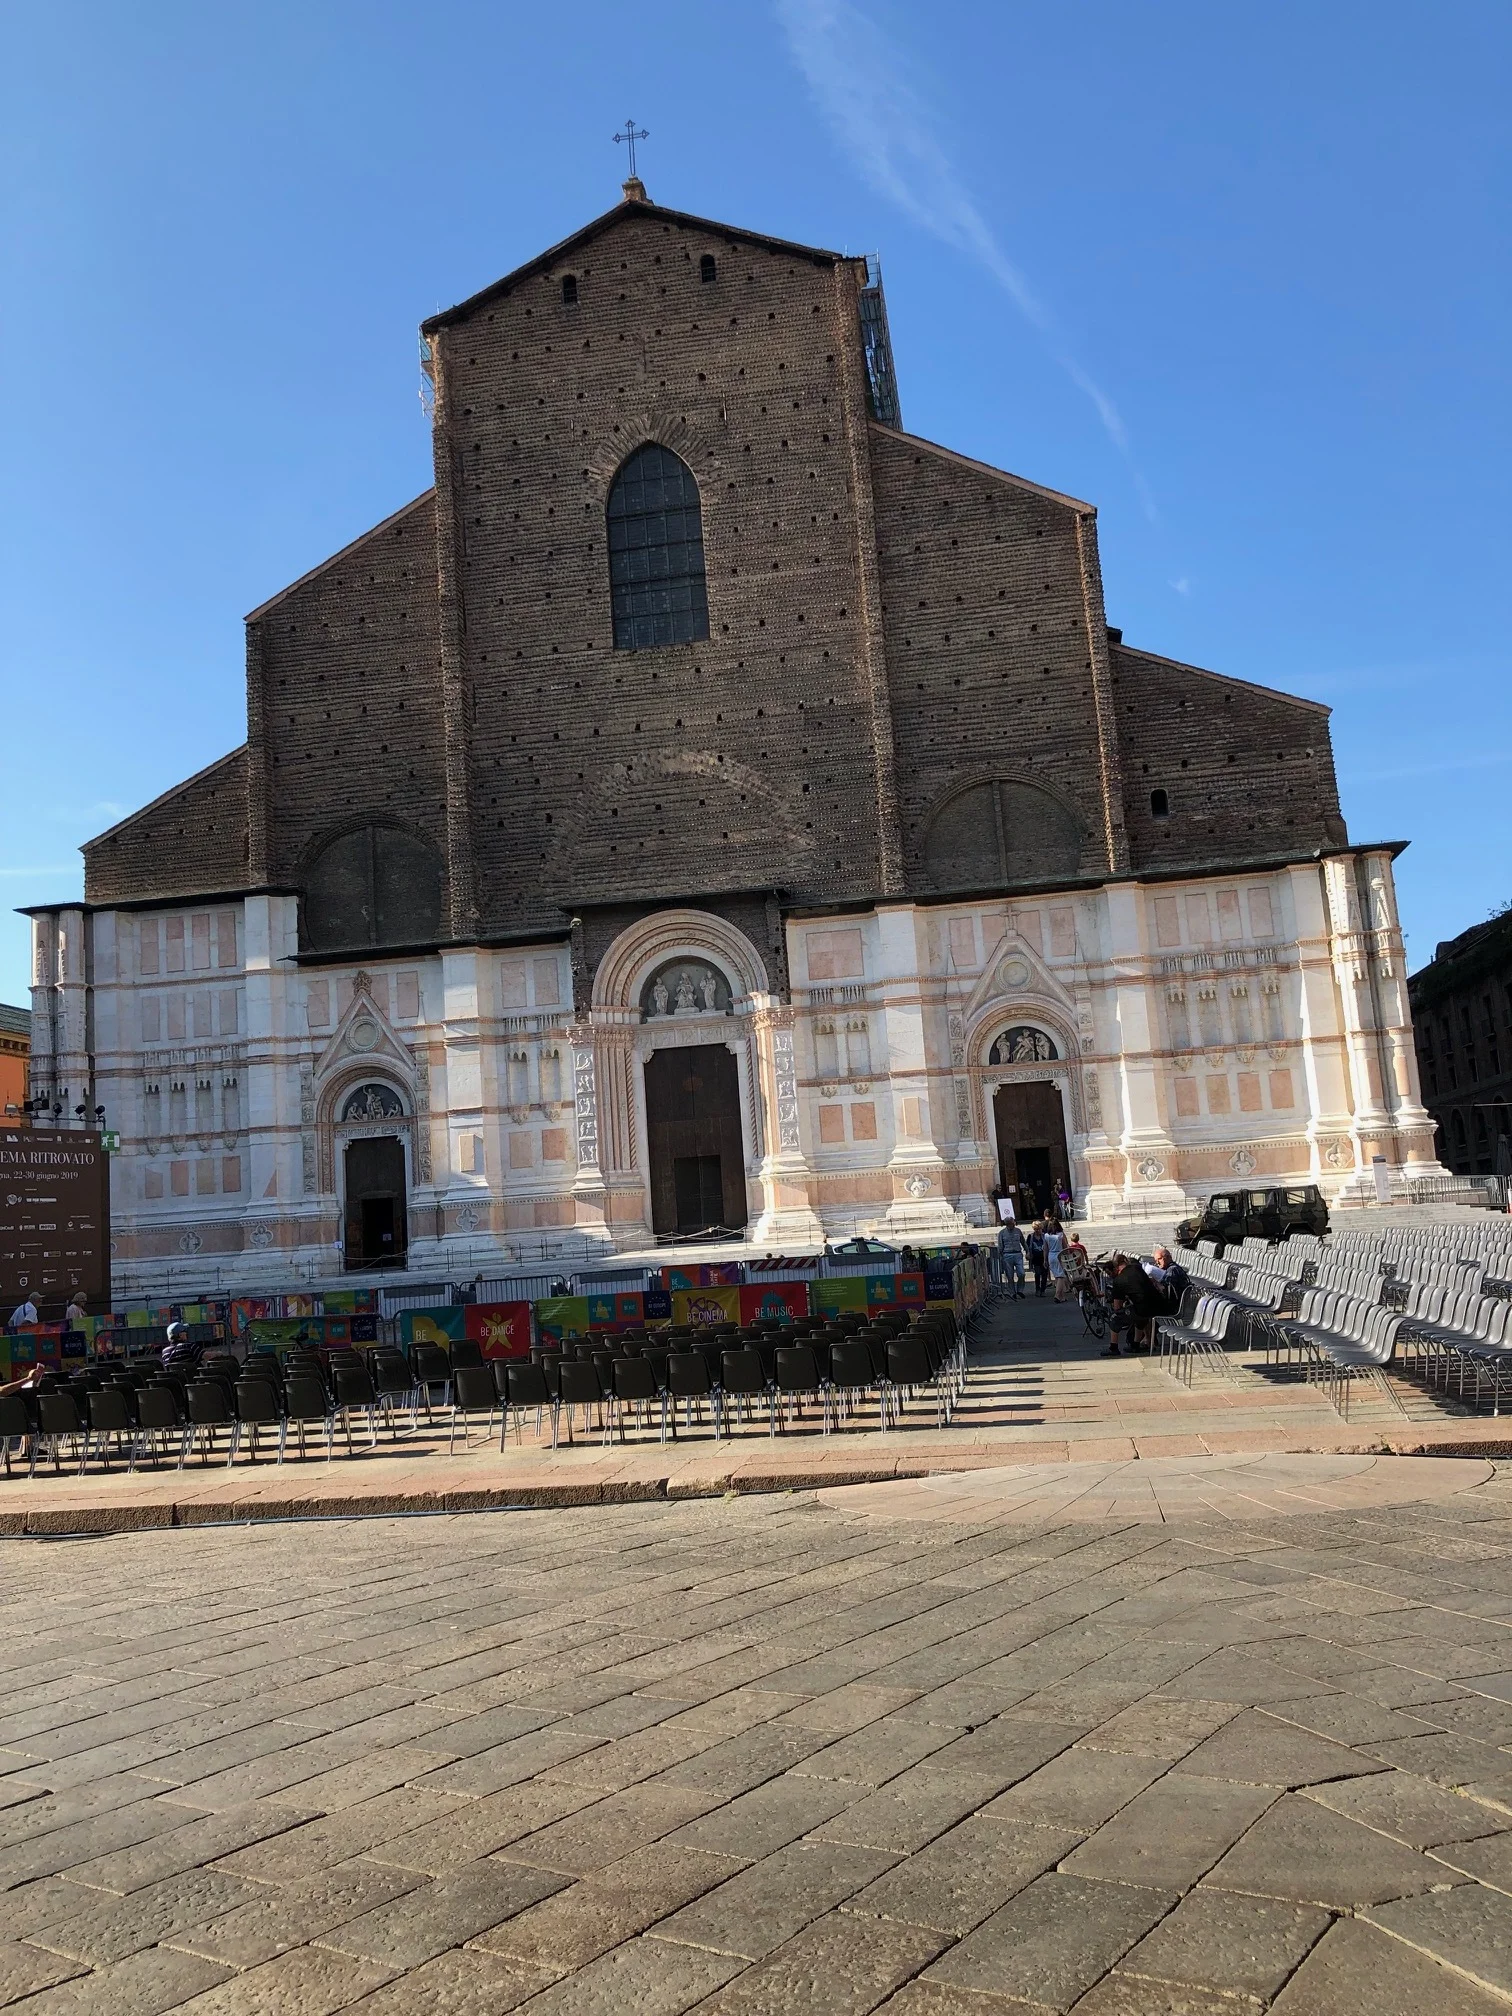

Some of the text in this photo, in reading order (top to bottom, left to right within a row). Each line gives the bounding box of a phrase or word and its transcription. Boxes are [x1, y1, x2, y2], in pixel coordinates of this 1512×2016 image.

[30, 1151, 95, 1165] RITROVATO
[13, 1170, 35, 1179] 22-30
[36, 1171, 60, 1182] giugno
[60, 1171, 79, 1180] 2019
[686, 1309, 728, 1323] BE CINEMA
[754, 1305, 794, 1318] BE MUSIC
[415, 1329, 426, 1341] BE
[480, 1324, 515, 1337] BE DANCE
